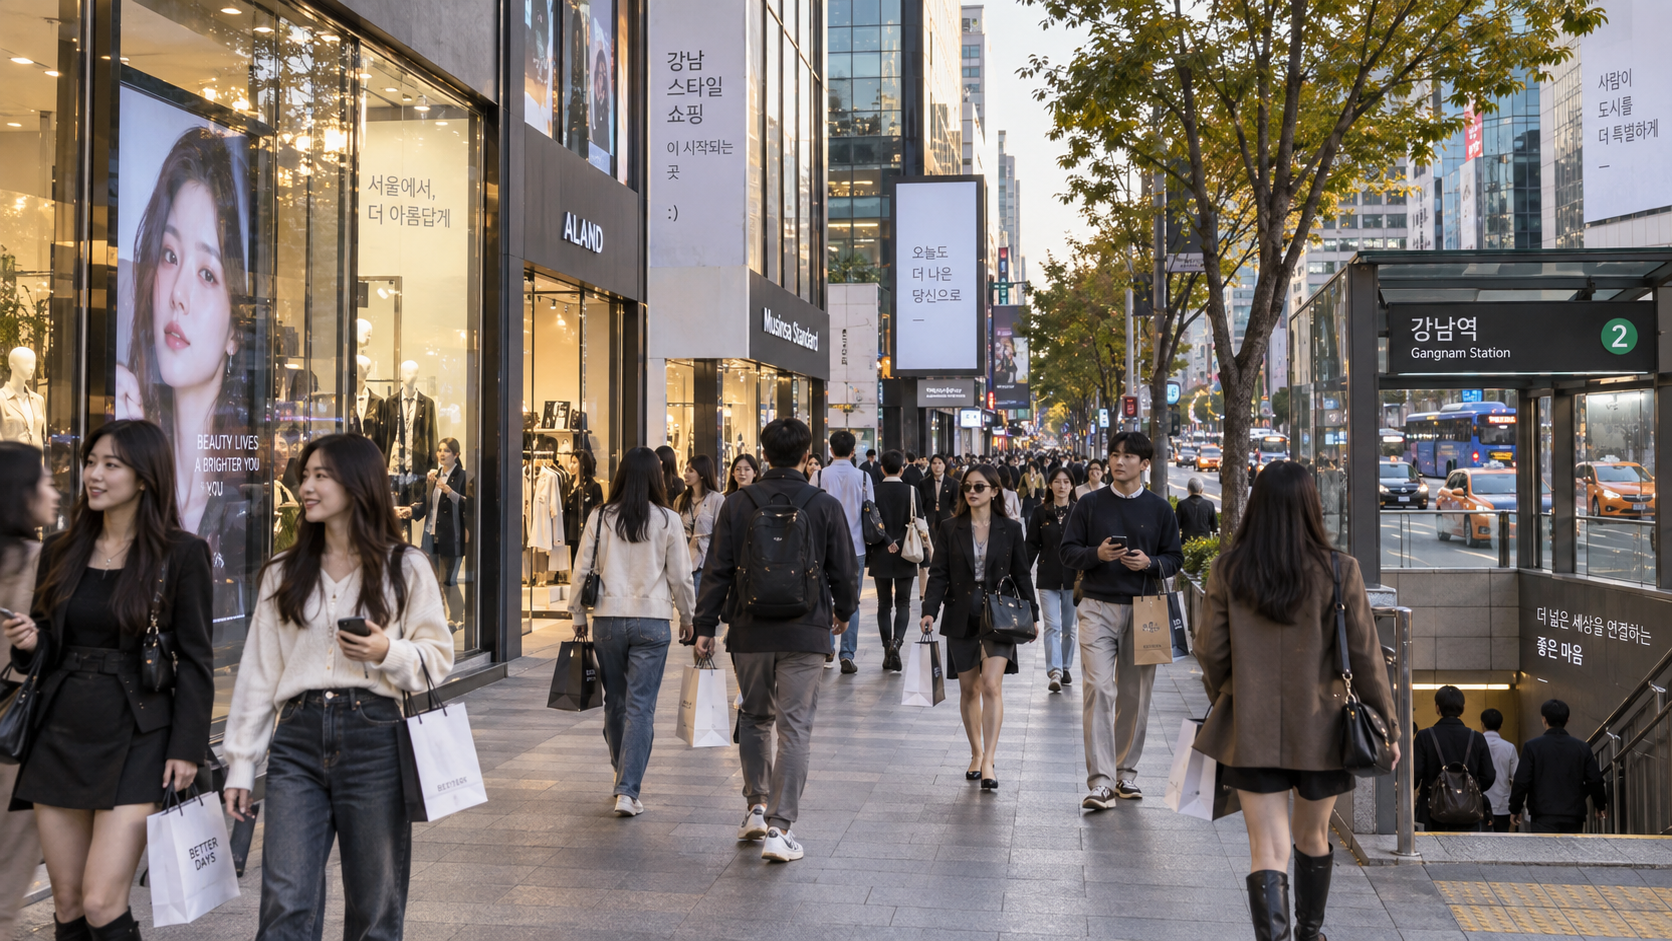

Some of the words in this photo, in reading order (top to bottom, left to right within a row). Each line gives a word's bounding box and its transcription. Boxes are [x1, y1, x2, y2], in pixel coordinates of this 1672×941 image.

[667, 50, 704, 71] 강남
[667, 76, 723, 97] 스타일
[1598, 68, 1632, 91] 사람이
[667, 104, 703, 124] 쇼핑
[1598, 96, 1633, 118] 도시를
[1599, 127, 1608, 145] 더
[1612, 119, 1658, 143] 특별하게
[667, 141, 679, 156] 이
[683, 140, 733, 155] 시작되는
[667, 165, 680, 180] 곳
[368, 174, 436, 201] 서울에서,
[368, 203, 383, 225] 더
[564, 212, 603, 253] ALAND
[912, 245, 948, 260] 오늘도
[912, 267, 924, 282] 더
[928, 266, 952, 282] 나은
[912, 288, 962, 303] 당신으로
[1411, 316, 1477, 341] 강남역
[1612, 325, 1628, 347] 2
[1411, 347, 1465, 361] Gangnam
[1469, 346, 1511, 359] Station
[197, 434, 232, 450] BEAUTY
[235, 434, 259, 450] LIVES
[194, 457, 201, 472] A
[203, 457, 242, 472] BRIGHTER
[244, 457, 260, 472] YOU
[1537, 606, 1547, 625] 더
[1572, 613, 1604, 637] 세상을
[1607, 619, 1652, 646] 연결하는
[1536, 636, 1558, 660] 좋은
[1561, 642, 1584, 666] 마음
[189, 836, 219, 860] BETTER
[195, 851, 217, 871] DAYS
